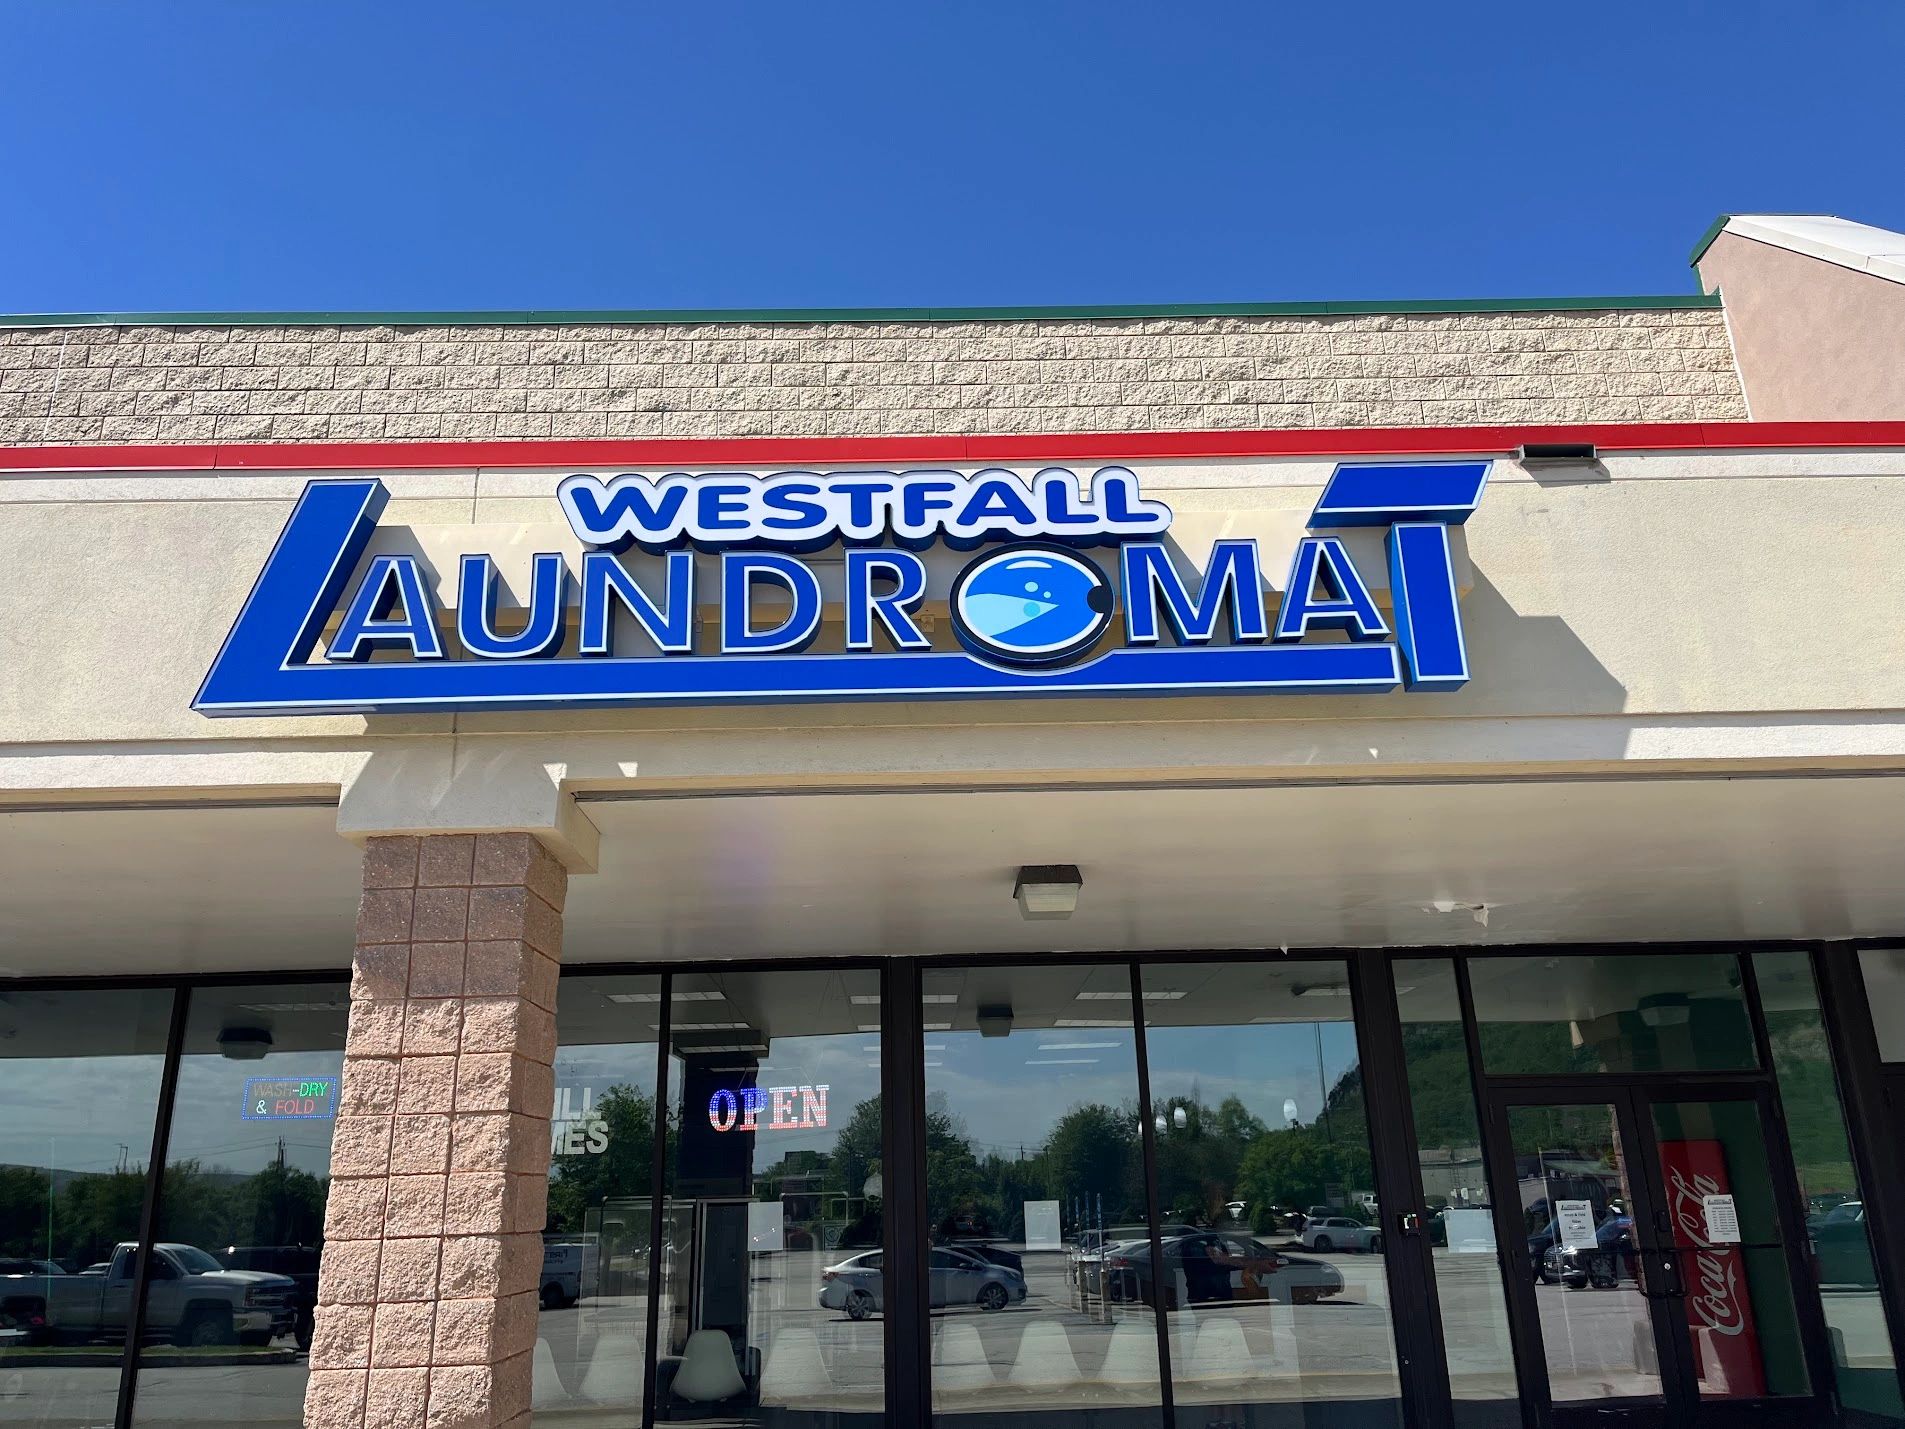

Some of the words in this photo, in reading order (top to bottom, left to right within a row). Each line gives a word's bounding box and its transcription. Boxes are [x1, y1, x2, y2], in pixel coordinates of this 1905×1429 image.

[566, 475, 1164, 536] WESTFALL
[191, 461, 1493, 712] LAUNDROMAT
[256, 1100, 267, 1114] &
[275, 1099, 315, 1114] FOLD
[709, 1085, 829, 1132] OPEN
